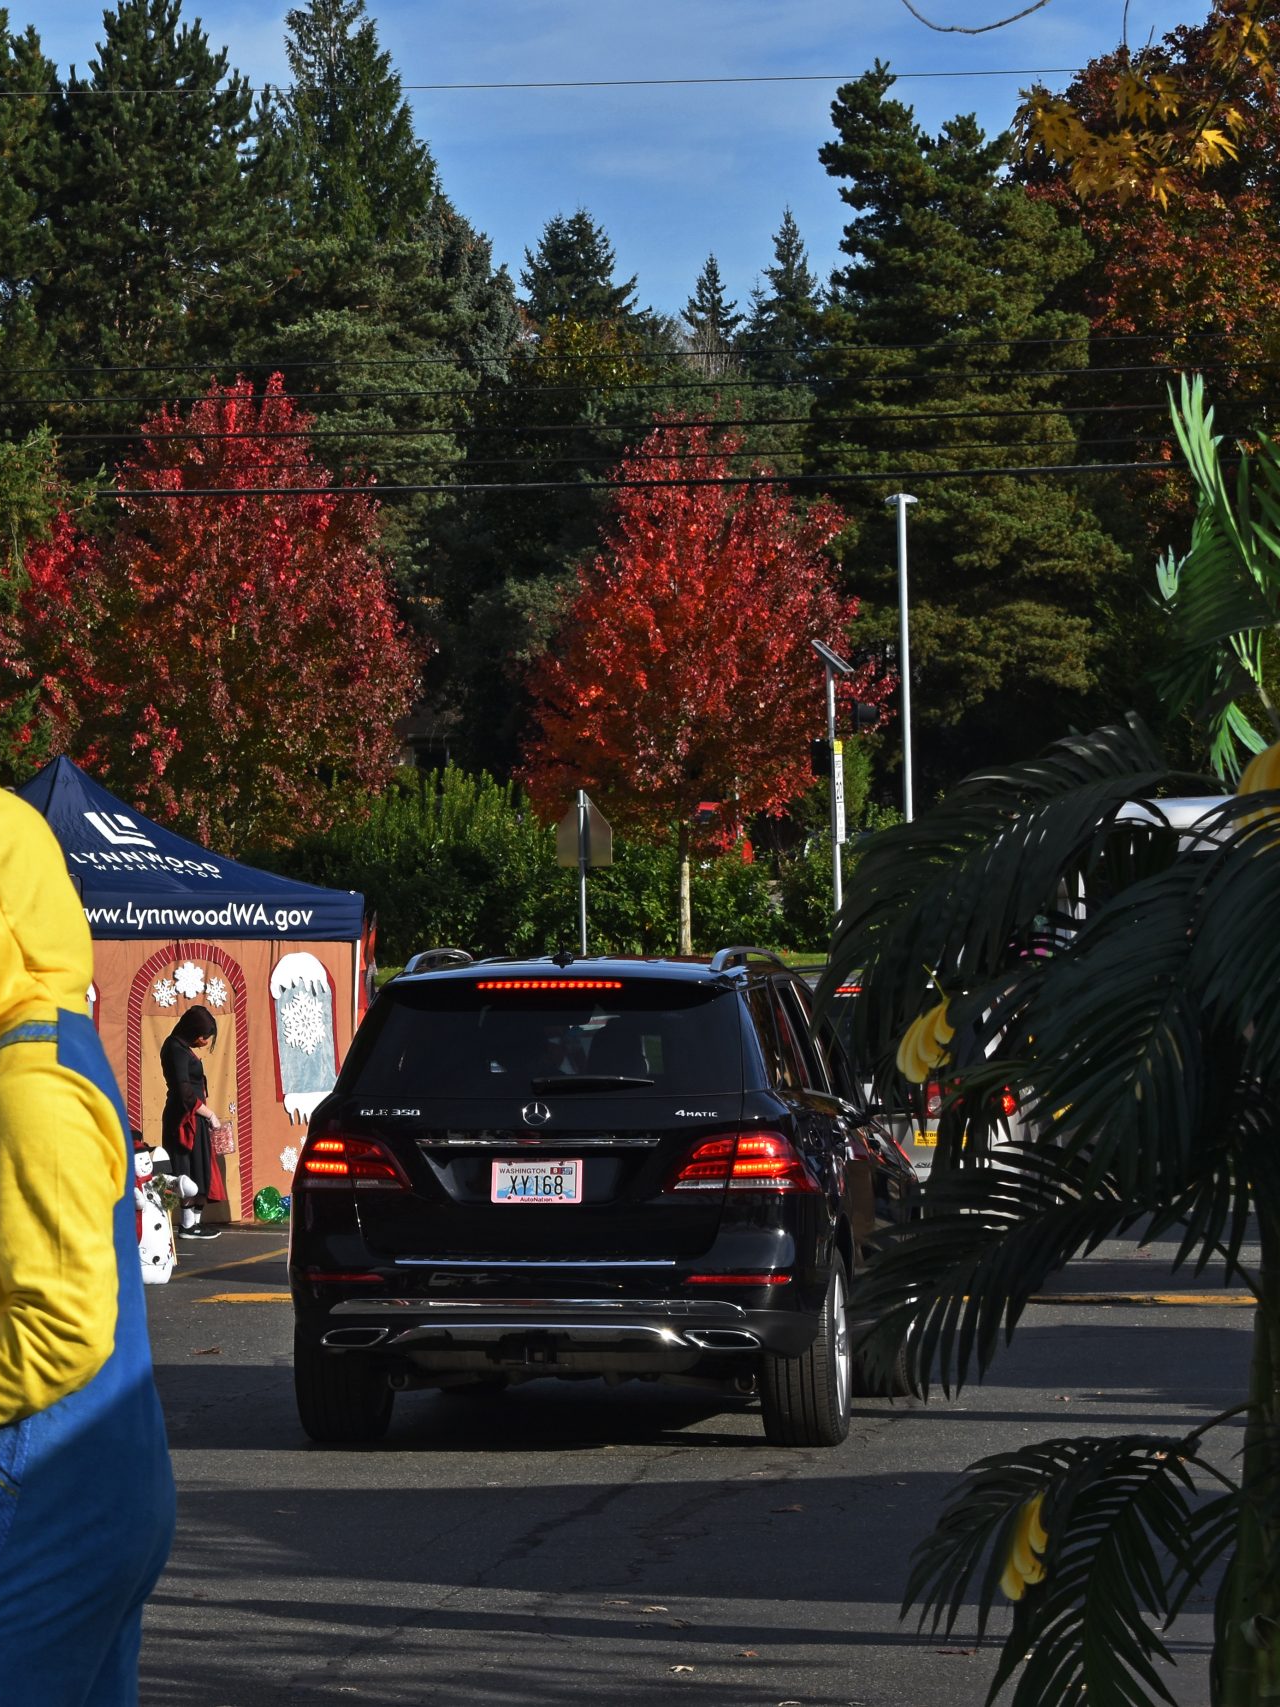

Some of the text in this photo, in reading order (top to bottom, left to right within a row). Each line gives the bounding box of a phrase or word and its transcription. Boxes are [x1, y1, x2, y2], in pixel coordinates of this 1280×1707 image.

[70, 851, 220, 874] LYNNWOOD
[94, 864, 223, 880] WASHINGTON
[391, 1108, 420, 1116] 350
[675, 1109, 718, 1118] 4MATIC
[499, 1167, 546, 1175] WASHINGTON
[510, 1175, 563, 1196] XY168
